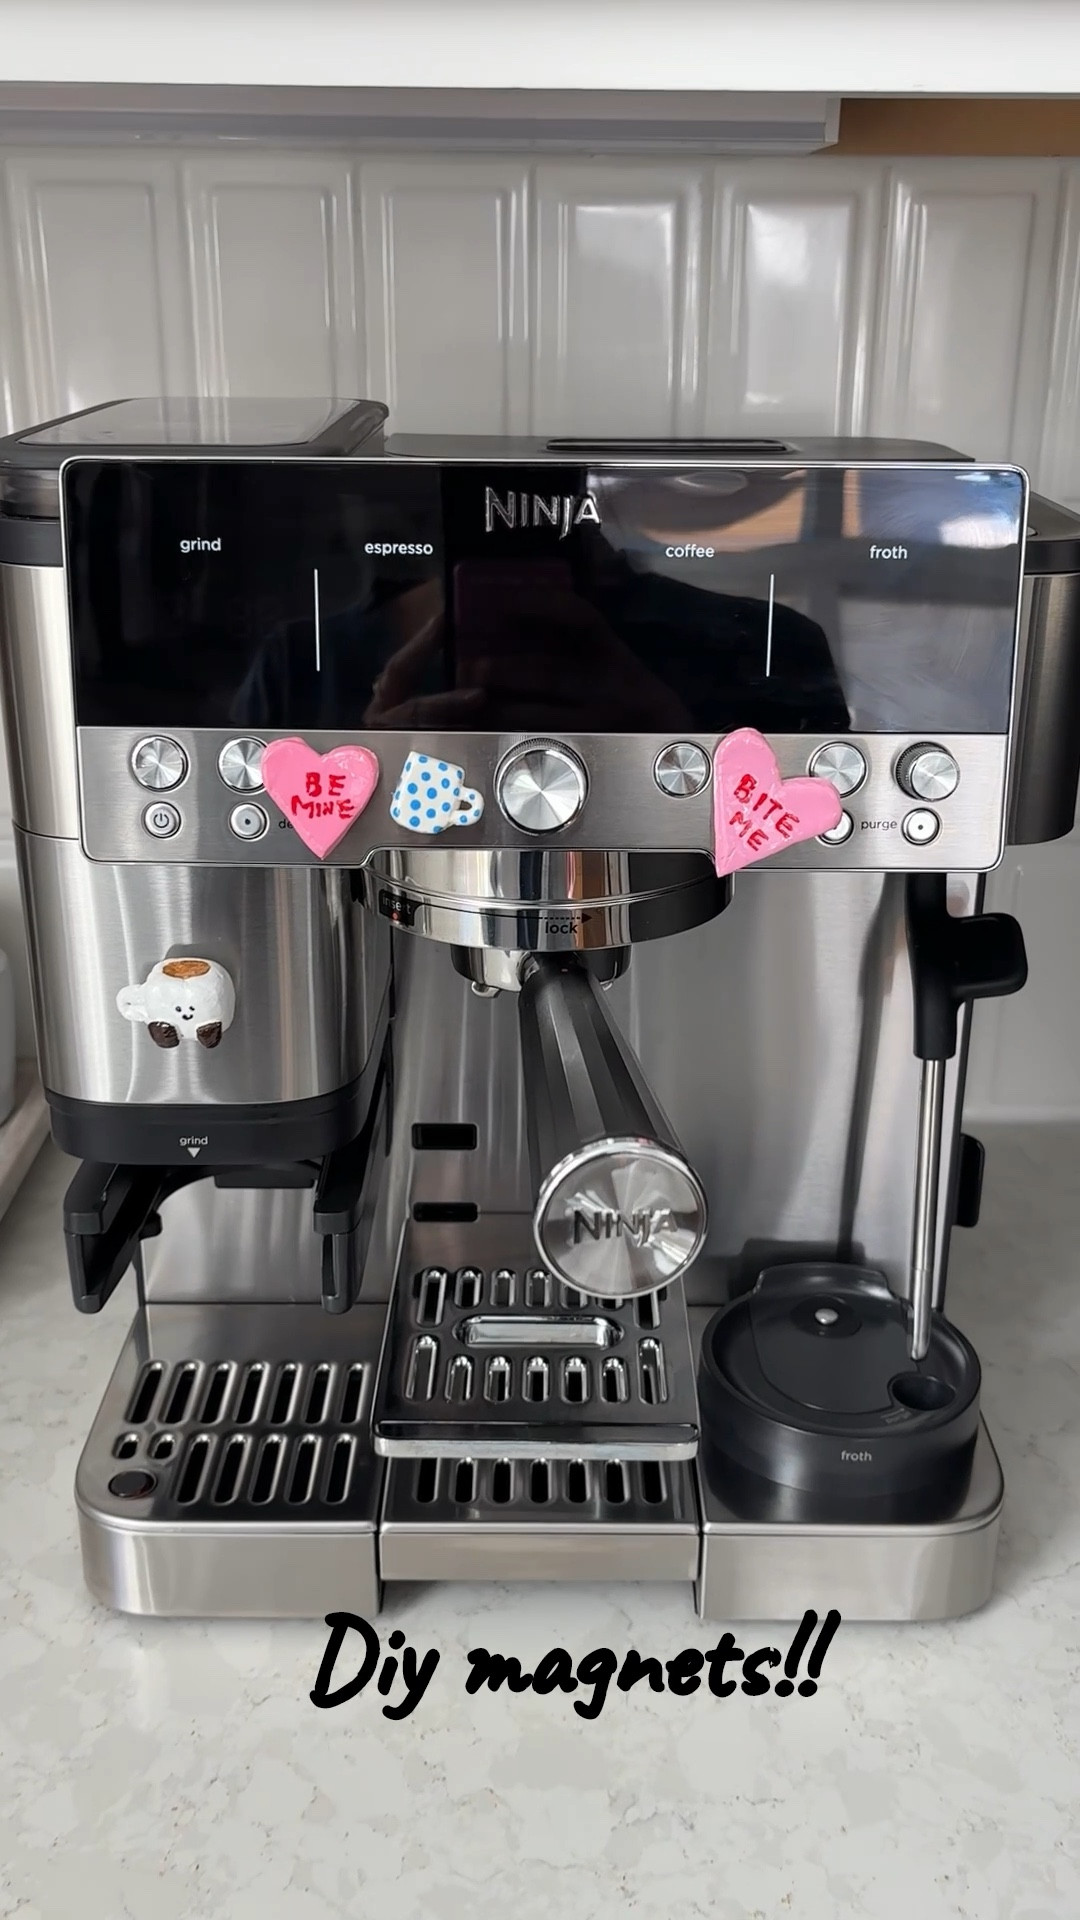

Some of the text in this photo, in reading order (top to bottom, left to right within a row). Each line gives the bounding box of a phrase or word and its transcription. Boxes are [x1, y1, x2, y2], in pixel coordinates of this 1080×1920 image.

[485, 487, 601, 540] NINJA
[180, 537, 222, 553] grind
[364, 543, 434, 557] espresso
[665, 543, 715, 558] coffee
[869, 544, 908, 560] froth
[306, 772, 346, 797] BE
[291, 795, 355, 819] MINE
[734, 774, 800, 839] BITE
[729, 811, 769, 851] ME
[861, 820, 898, 831] purge
[382, 893, 411, 915] inset
[545, 921, 578, 934] lock
[179, 1135, 209, 1146] grind
[573, 1208, 679, 1247] NINJA
[841, 1450, 872, 1461] froth
